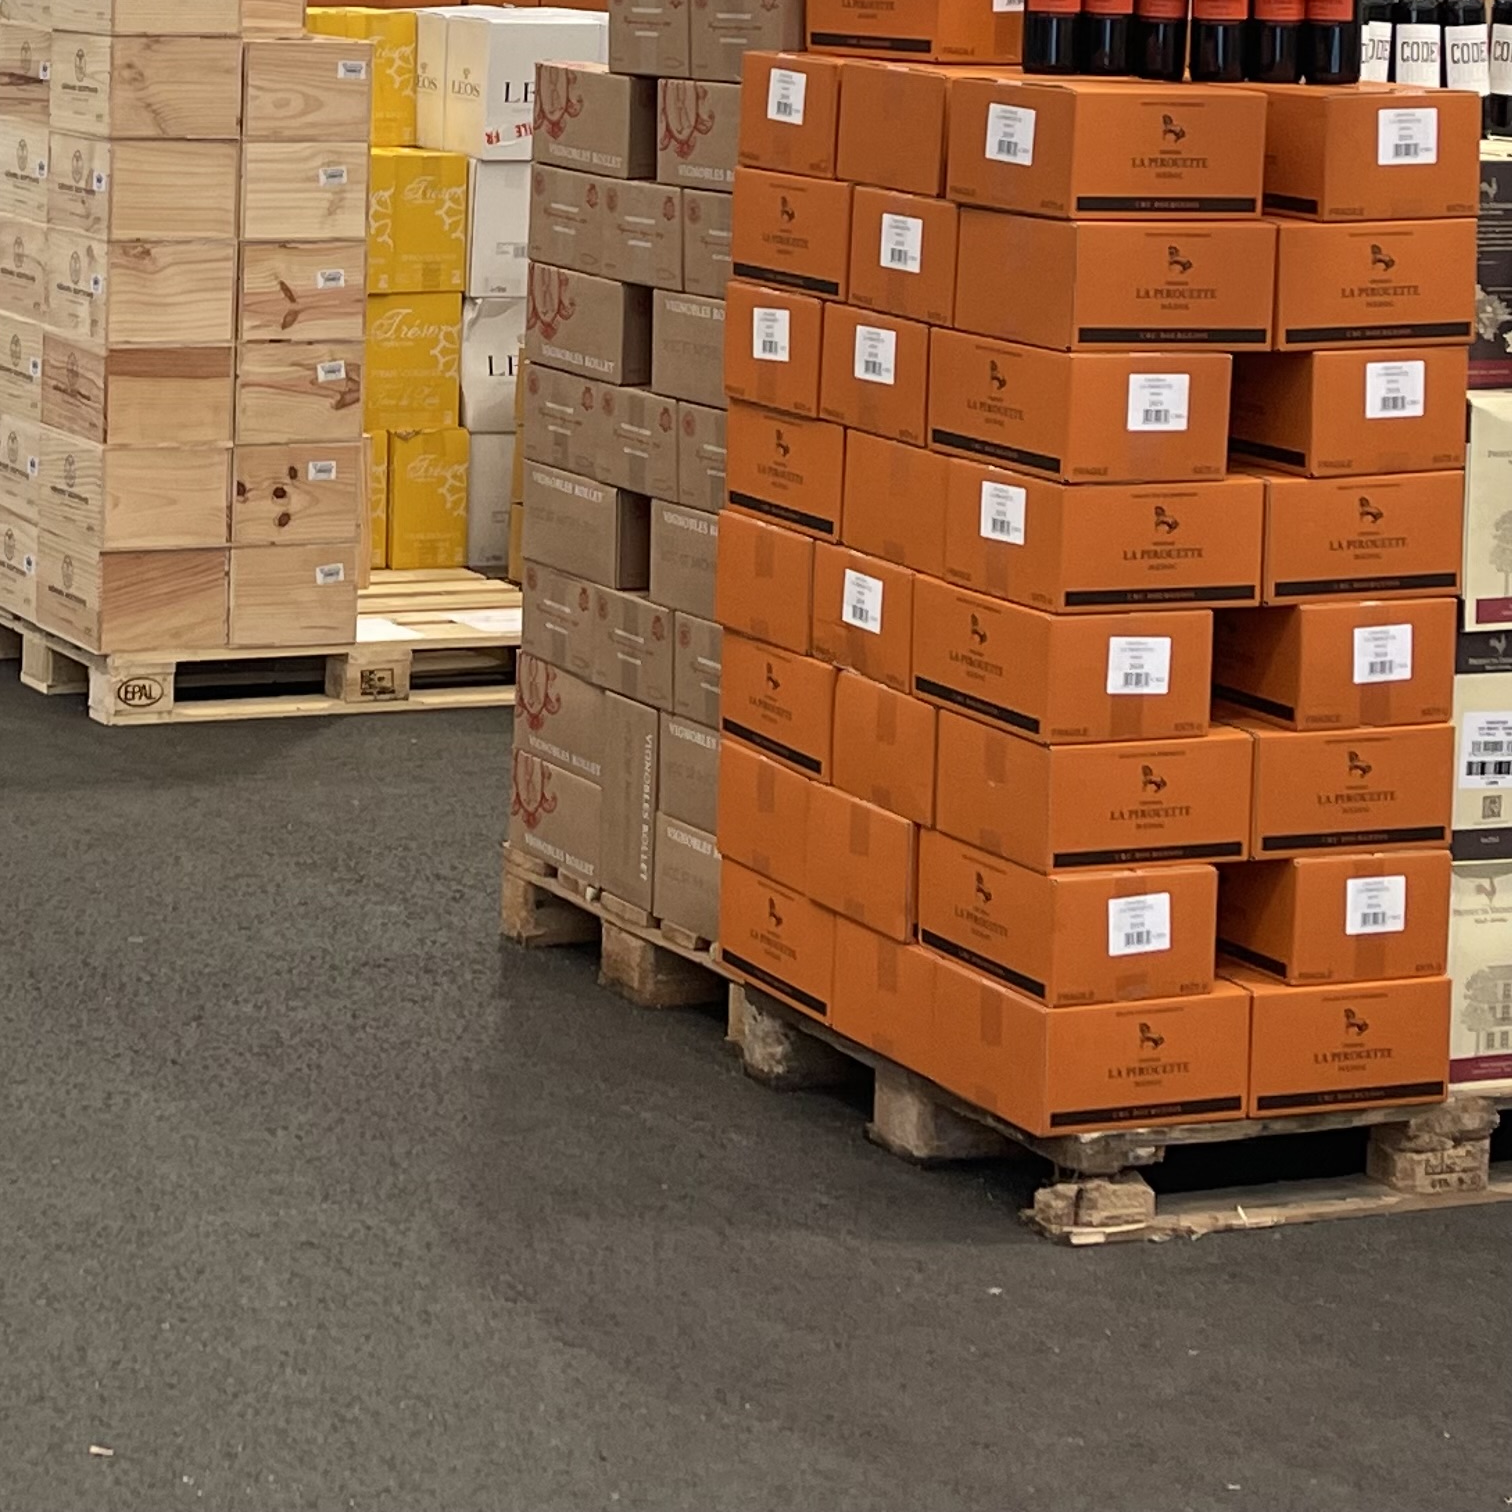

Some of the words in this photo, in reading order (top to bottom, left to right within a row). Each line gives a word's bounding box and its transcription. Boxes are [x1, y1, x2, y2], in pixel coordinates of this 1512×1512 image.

[1400, 41, 1438, 63] CODE
[1450, 41, 1488, 64] CODE
[1493, 40, 1512, 61] CO
[451, 80, 481, 98] LEOS
[504, 81, 535, 104] LE
[1131, 157, 1146, 168] LA
[1135, 288, 1151, 299] LA
[1340, 287, 1355, 298] LA
[487, 355, 518, 376] LE
[1329, 539, 1344, 551] LA
[1123, 550, 1137, 561] LA
[123, 683, 156, 702] EPAL
[1317, 794, 1331, 805] LA
[1110, 809, 1126, 821] LA
[1314, 1053, 1328, 1065] LA
[1108, 1067, 1123, 1080] LA
